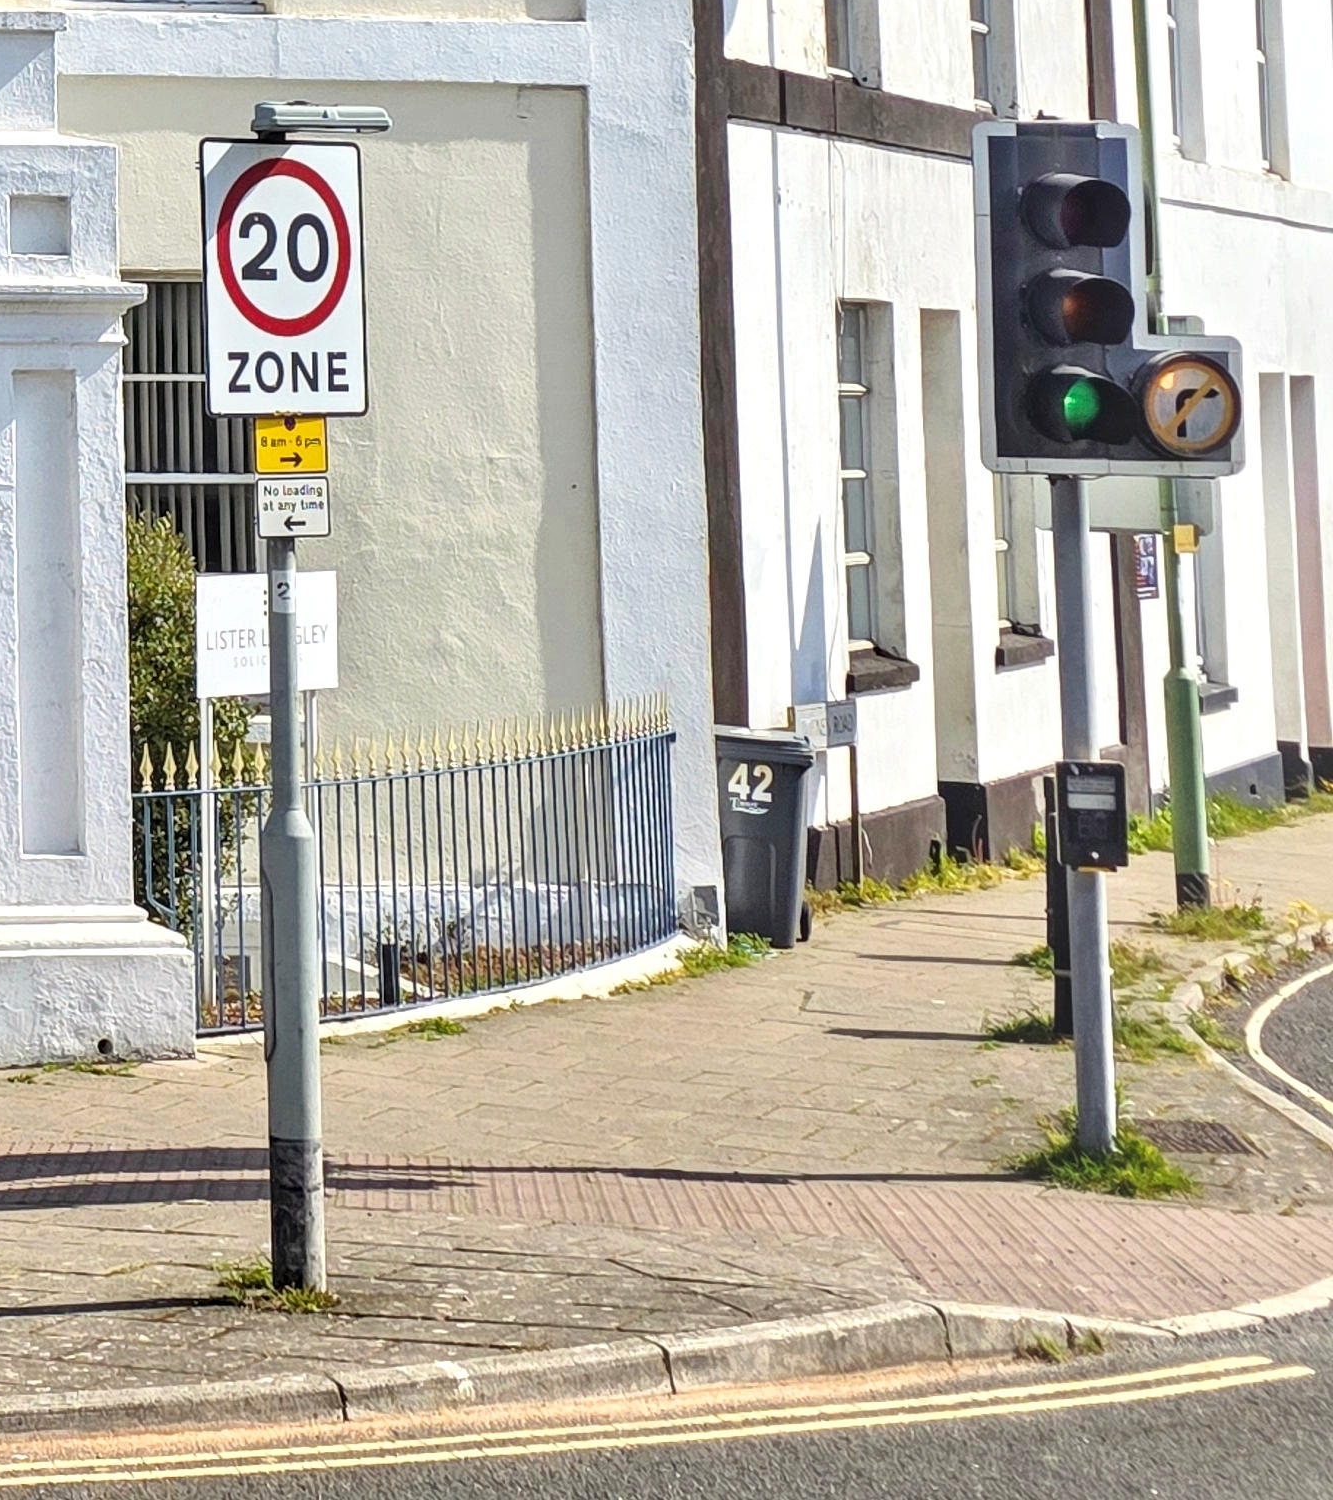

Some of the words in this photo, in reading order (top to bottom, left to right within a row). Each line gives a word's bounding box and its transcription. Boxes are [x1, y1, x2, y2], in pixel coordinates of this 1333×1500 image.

[238, 212, 330, 283] 20
[228, 351, 350, 394] ZONE
[263, 485, 279, 496] No
[282, 484, 323, 498] loading
[262, 500, 274, 512] at
[278, 501, 297, 513] any
[300, 499, 324, 510] time
[276, 582, 291, 601] 2
[206, 628, 257, 651] LISTER
[261, 623, 329, 647] LGLEY
[728, 763, 774, 803] 42
